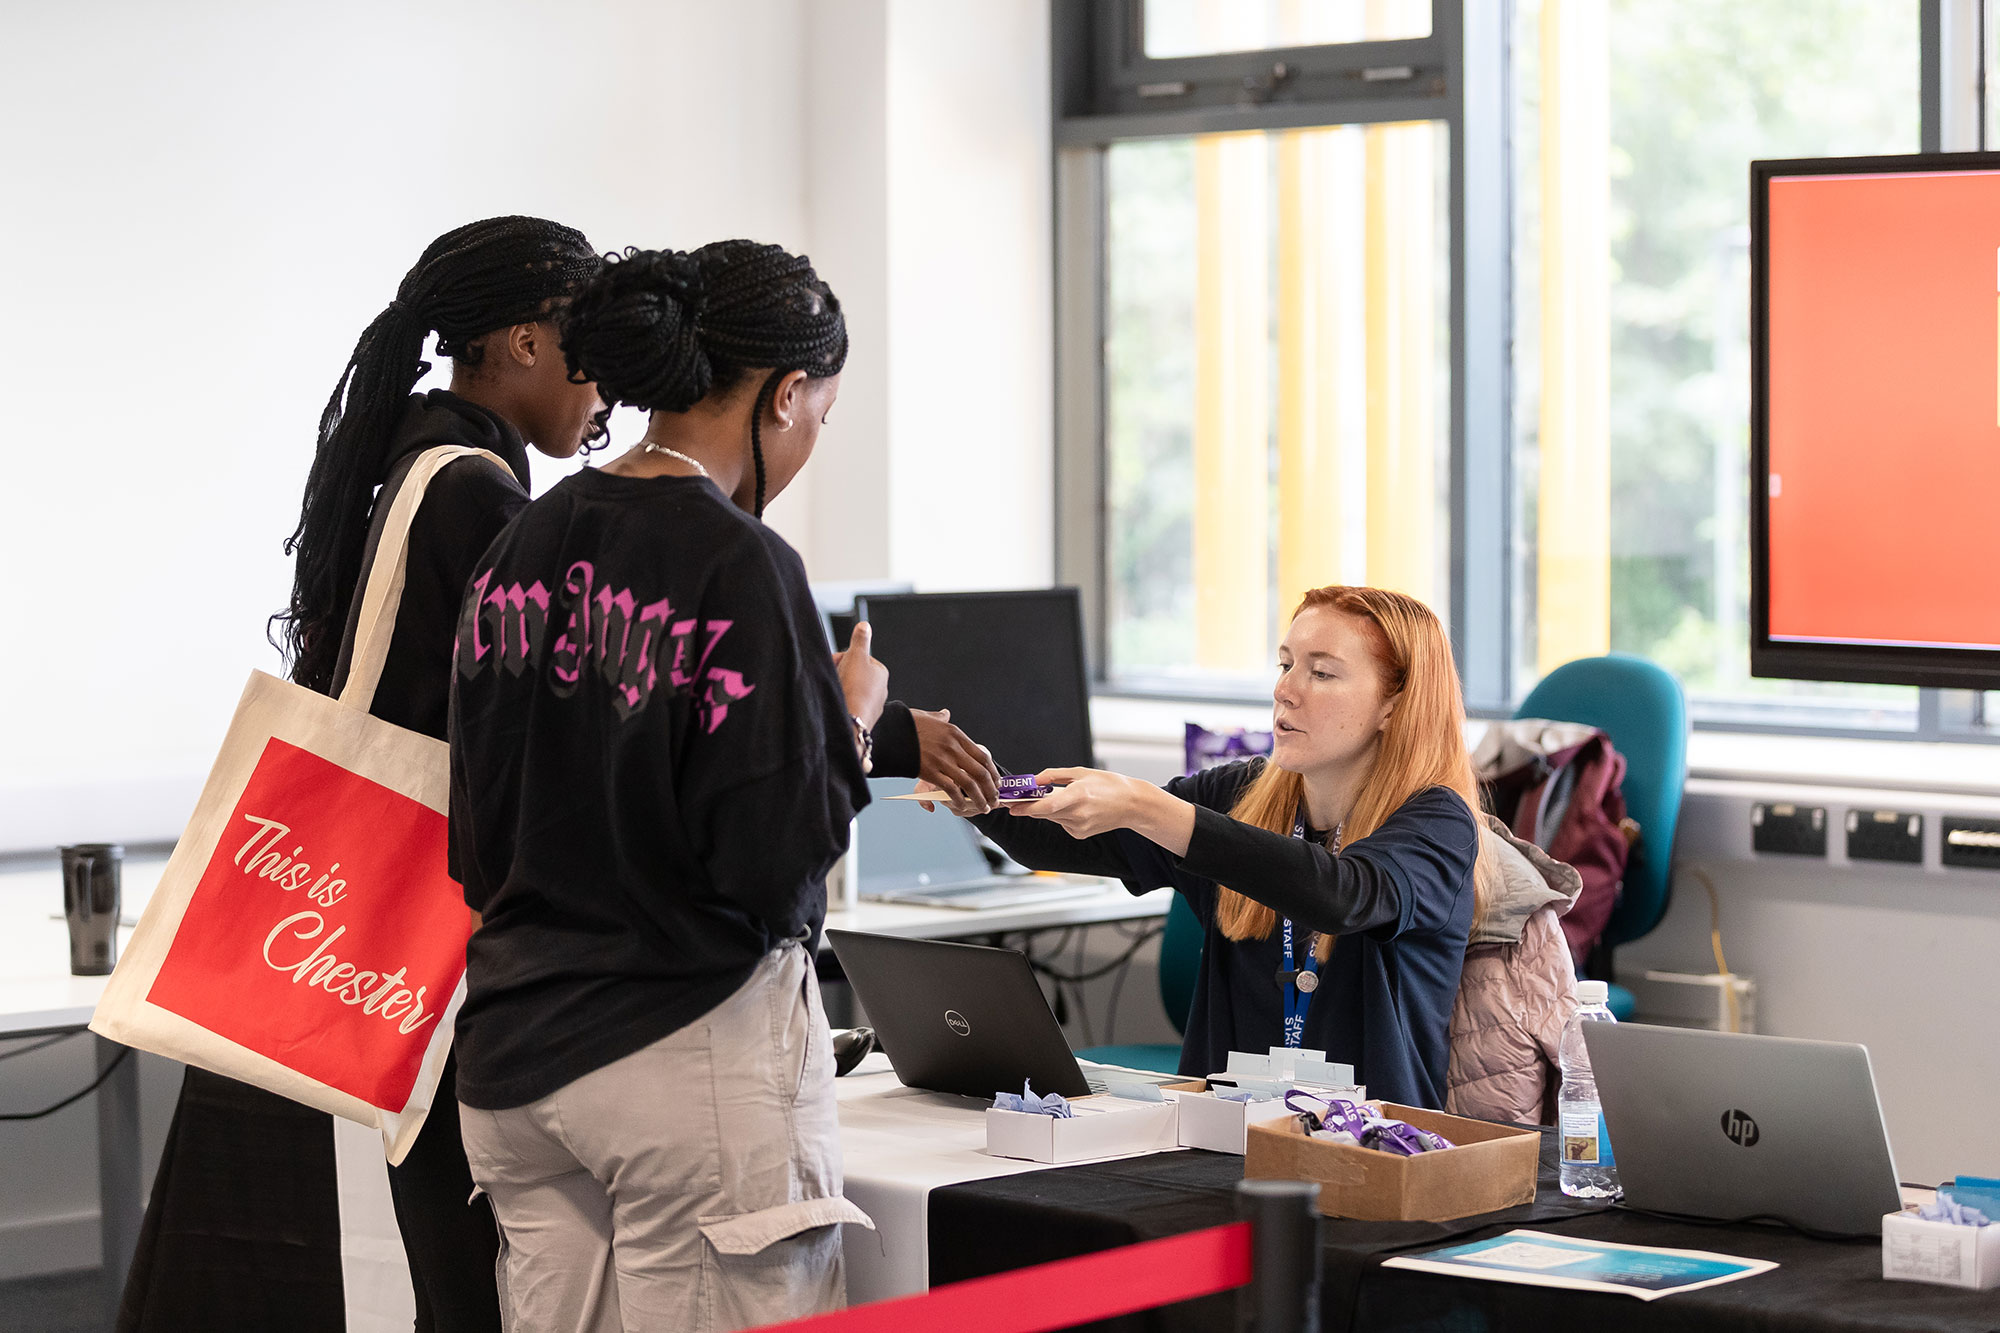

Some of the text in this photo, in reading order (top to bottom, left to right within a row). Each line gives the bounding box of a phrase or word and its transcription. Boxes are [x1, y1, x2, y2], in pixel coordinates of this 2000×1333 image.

[999, 777, 1033, 788] TUDENT
[234, 813, 348, 908] This is
[1283, 918, 1293, 959] STAFF
[262, 910, 435, 1035] Chester
[1290, 1013, 1304, 1049] TAFF
[1727, 1108, 1754, 1148] hp
